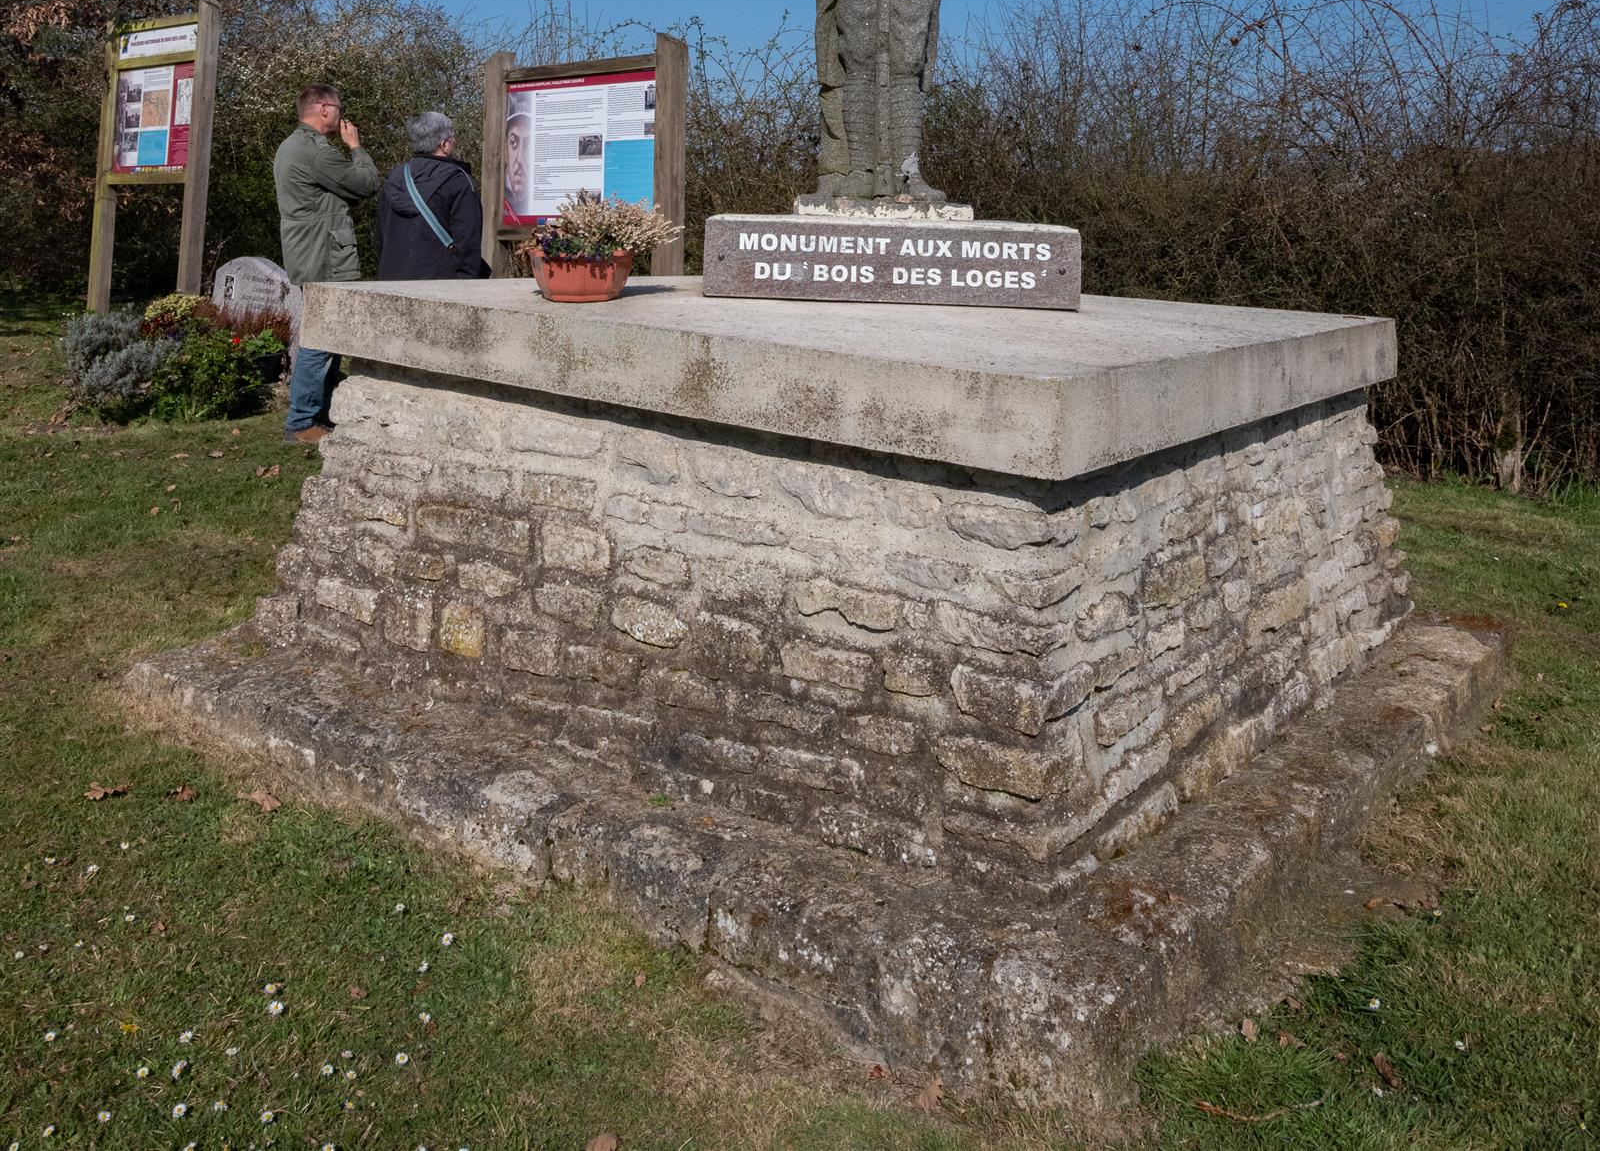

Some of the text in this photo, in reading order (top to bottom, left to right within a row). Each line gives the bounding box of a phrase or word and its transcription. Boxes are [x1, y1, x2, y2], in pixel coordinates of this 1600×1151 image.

[739, 232, 1051, 261] MONUMENT AUX MORTS
[754, 261, 792, 281] DU
[892, 267, 942, 286] DES
